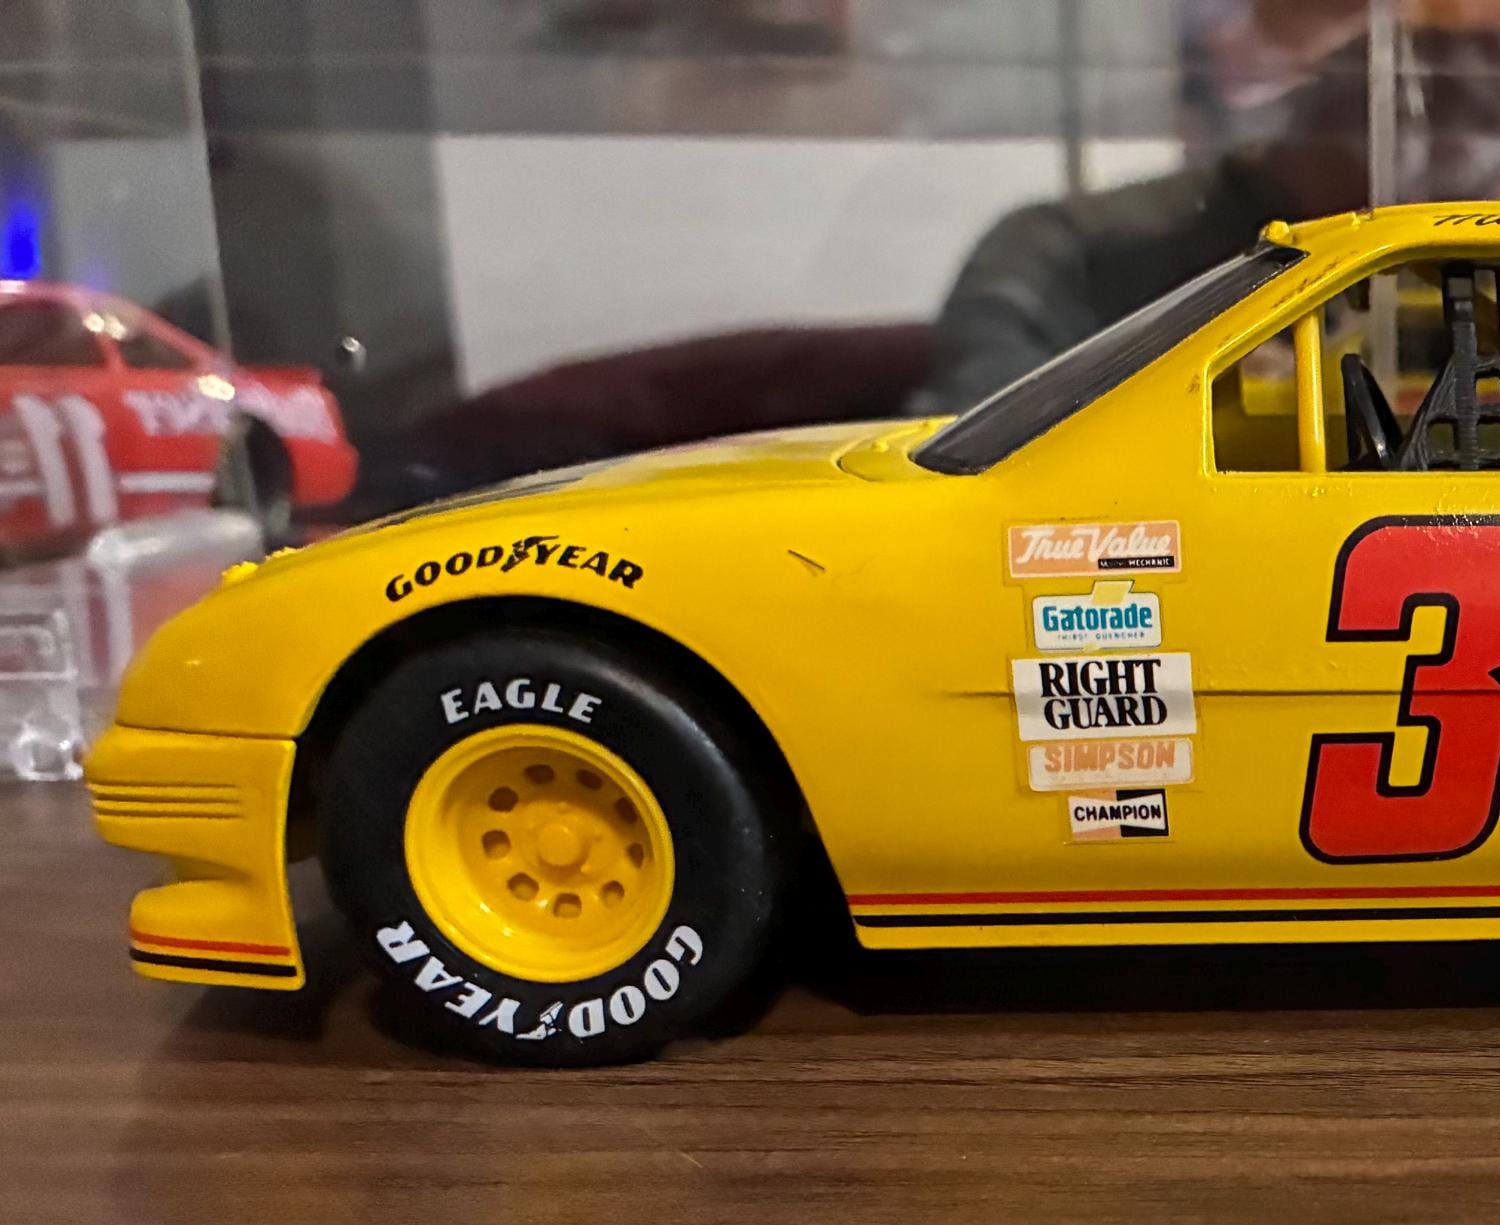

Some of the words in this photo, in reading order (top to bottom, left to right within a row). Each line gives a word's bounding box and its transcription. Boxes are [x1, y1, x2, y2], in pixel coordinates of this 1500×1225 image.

[1016, 527, 1085, 564] True
[1071, 524, 1172, 562] Value
[385, 535, 644, 602] GOODYEAR
[1042, 603, 1153, 632] Gatorade
[1038, 659, 1161, 698] RIGHT
[440, 678, 603, 724] EAGLE
[1044, 694, 1168, 730] GUARD
[1044, 741, 1176, 773] SIMPSON
[1073, 804, 1162, 822] CHAMPION
[376, 920, 704, 1041] GOODYEAR
